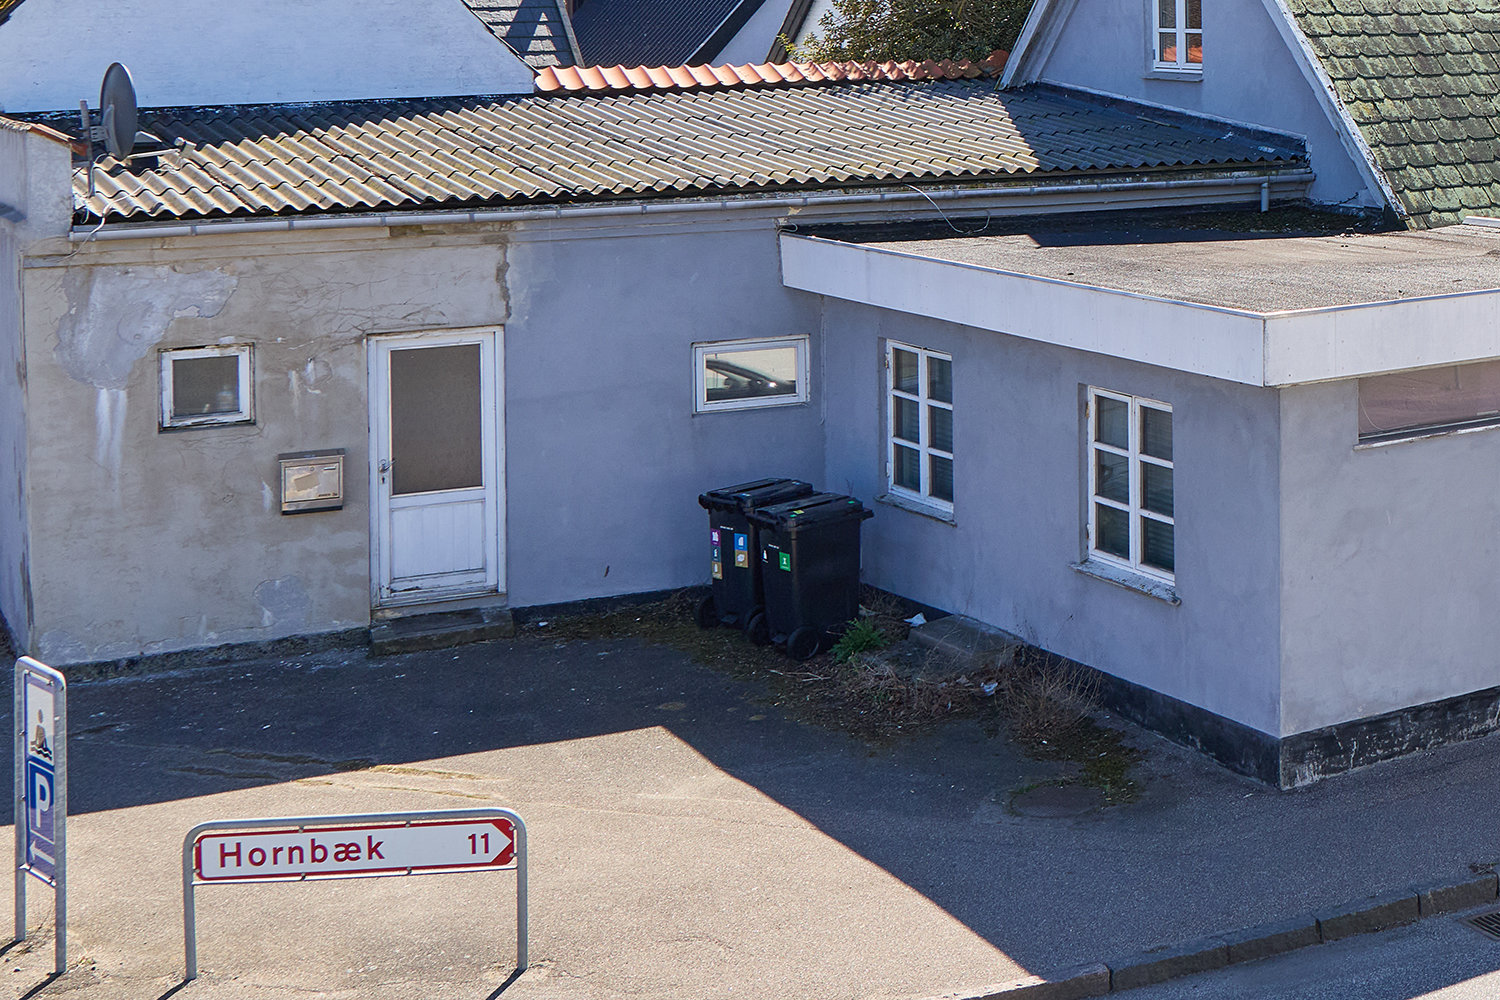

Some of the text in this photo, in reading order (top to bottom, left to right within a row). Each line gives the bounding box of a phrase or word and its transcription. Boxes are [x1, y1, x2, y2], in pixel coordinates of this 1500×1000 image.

[35, 772, 51, 828] P
[219, 833, 490, 868] Hornbæk 11
